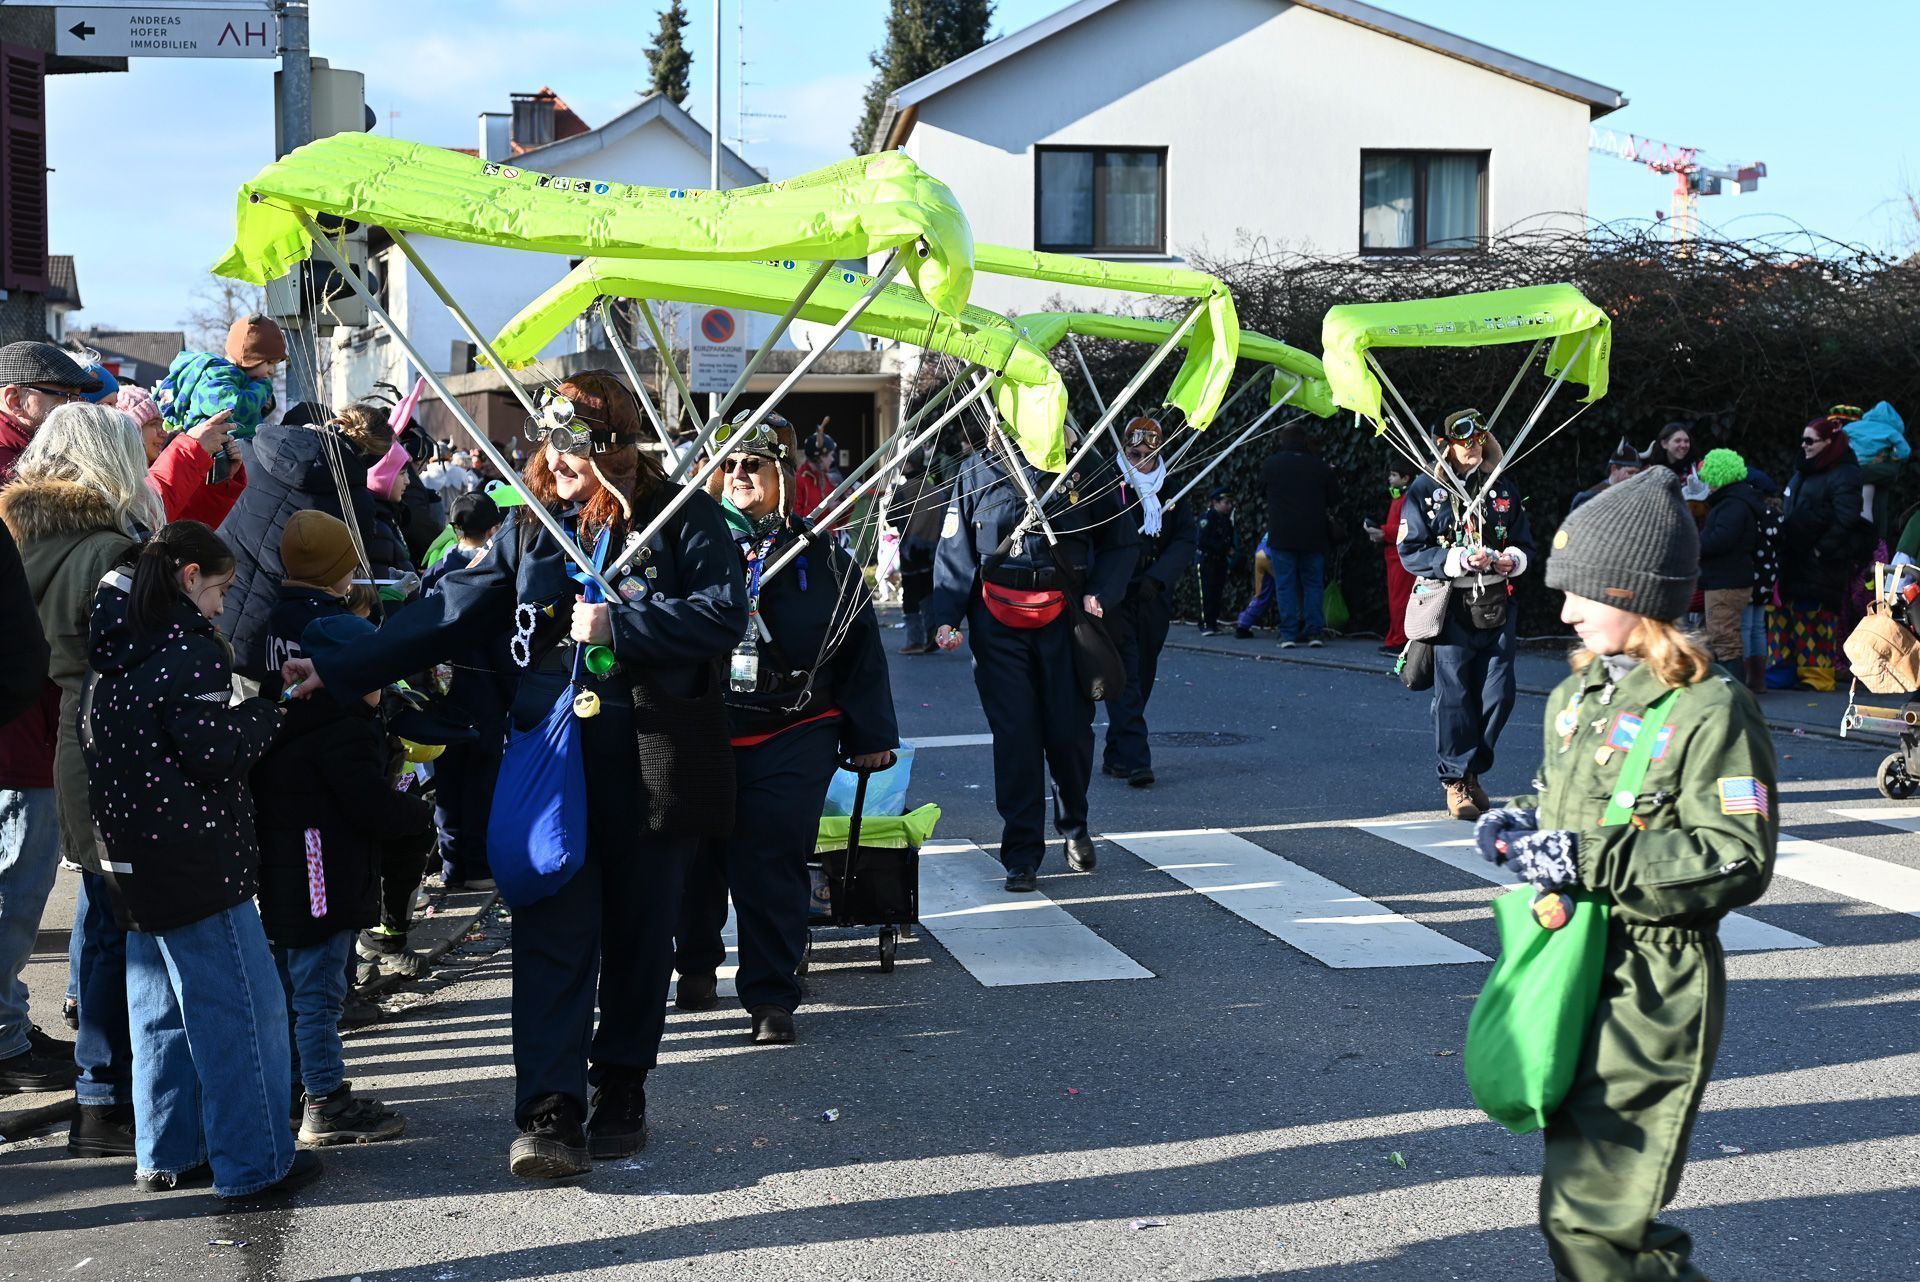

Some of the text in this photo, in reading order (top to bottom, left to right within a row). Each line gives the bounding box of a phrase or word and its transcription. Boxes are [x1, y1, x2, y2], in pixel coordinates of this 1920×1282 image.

[129, 15, 181, 25] ANDREAS
[130, 28, 167, 37] HOFER
[130, 39, 197, 49] IMMOBILIEN
